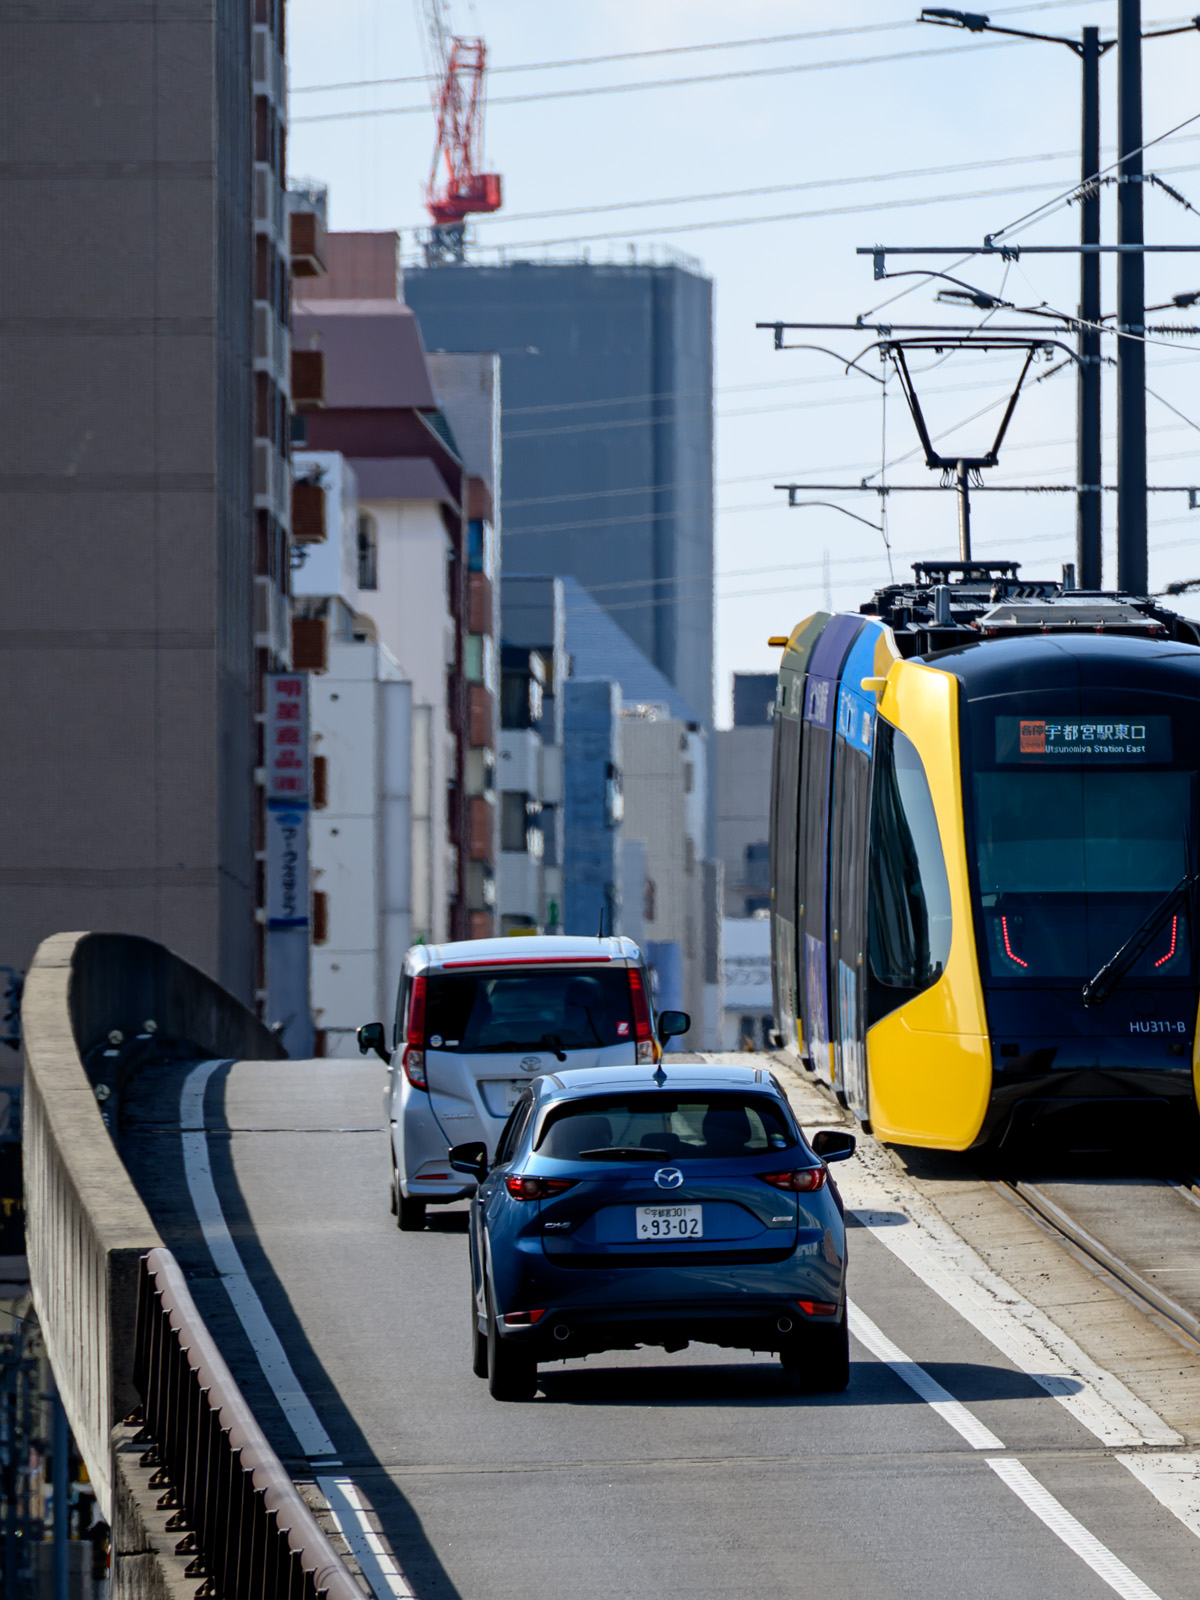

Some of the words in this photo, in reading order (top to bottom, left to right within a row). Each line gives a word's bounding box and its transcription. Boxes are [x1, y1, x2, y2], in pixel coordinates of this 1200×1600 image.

[1045, 724, 1146, 740] 宇都宮駅東口
[1045, 744, 1092, 753] Utsunomiya
[1094, 744, 1125, 753] Station
[1126, 744, 1146, 753] East
[1129, 1020, 1186, 1033] HU311-B
[651, 1218, 699, 1236] 93-02
